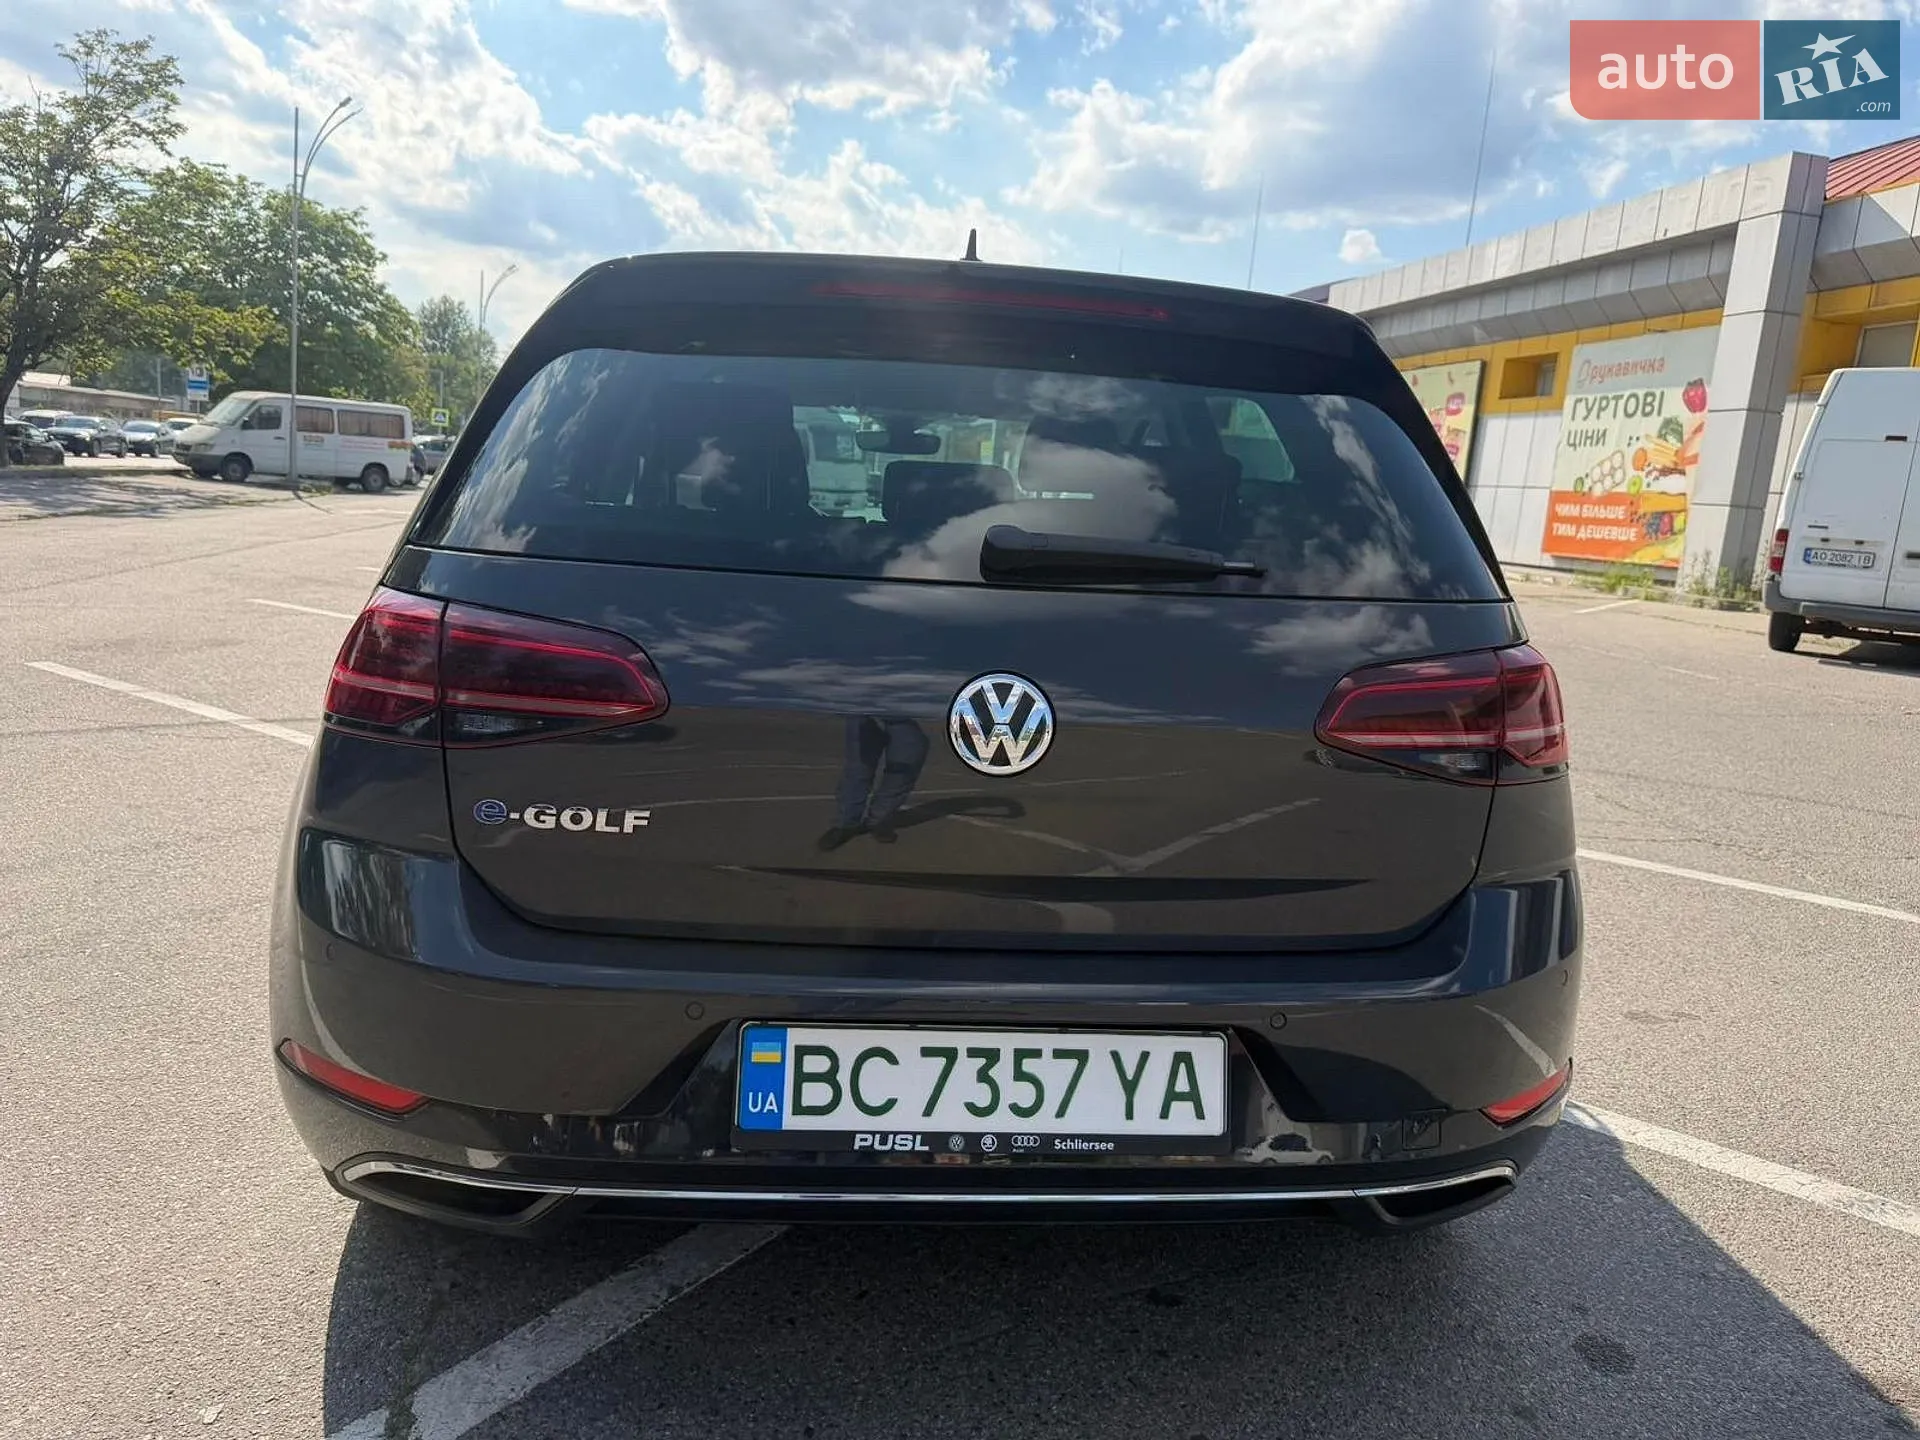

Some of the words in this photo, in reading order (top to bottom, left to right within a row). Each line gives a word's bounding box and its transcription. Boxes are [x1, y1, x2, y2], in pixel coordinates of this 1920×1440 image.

[1571, 390, 1665, 422] ГУРТОВІ
[1566, 428, 1608, 451] ЦІНИ
[1555, 503, 1580, 517] ЧИМ
[1581, 503, 1626, 519] БІЛЬШЕ
[1552, 522, 1576, 537] ТИМ
[1576, 524, 1638, 542] ДЕШЕВШЕ
[473, 799, 651, 834] e-GOLF
[791, 1045, 900, 1117] BC
[919, 1046, 1091, 1119] 7357
[1109, 1049, 1206, 1121] YA
[748, 1091, 778, 1113] UA
[853, 1134, 930, 1150] PUSL
[1054, 1138, 1115, 1151] Schliersee
